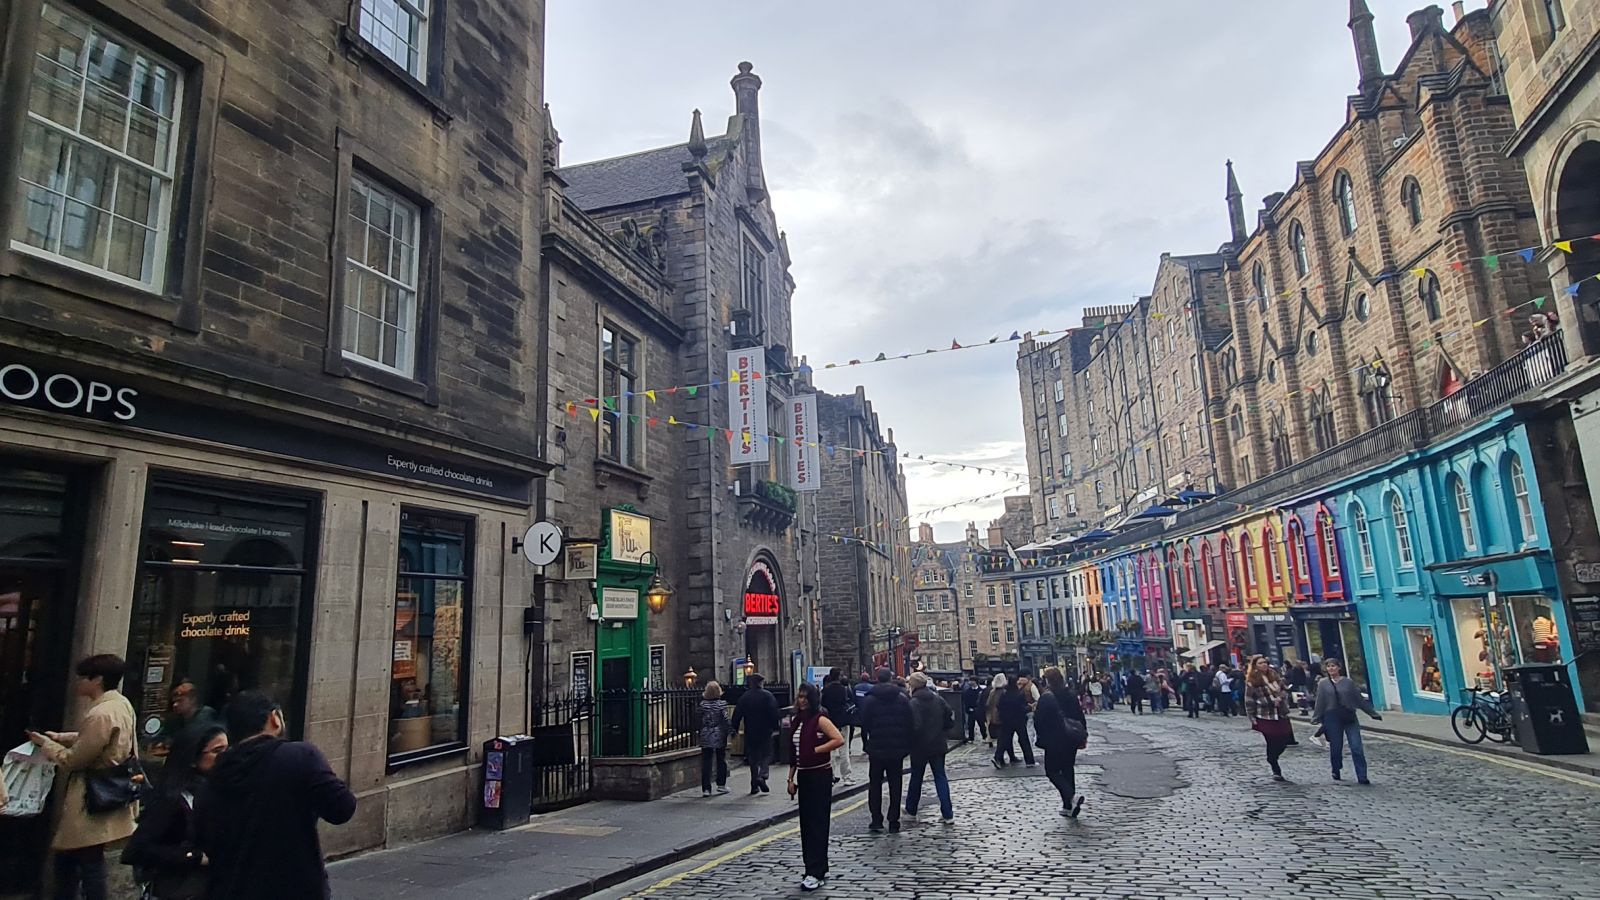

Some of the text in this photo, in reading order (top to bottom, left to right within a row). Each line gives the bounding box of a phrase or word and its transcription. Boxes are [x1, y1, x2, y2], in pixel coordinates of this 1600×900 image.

[0, 364, 138, 420] OOPS
[794, 402, 806, 484] BERTIES
[387, 455, 493, 488] Expertly crafted chocolate drinks
[540, 533, 554, 554] K
[181, 625, 223, 637] chocolate
[182, 610, 250, 627] Expertly crafted
